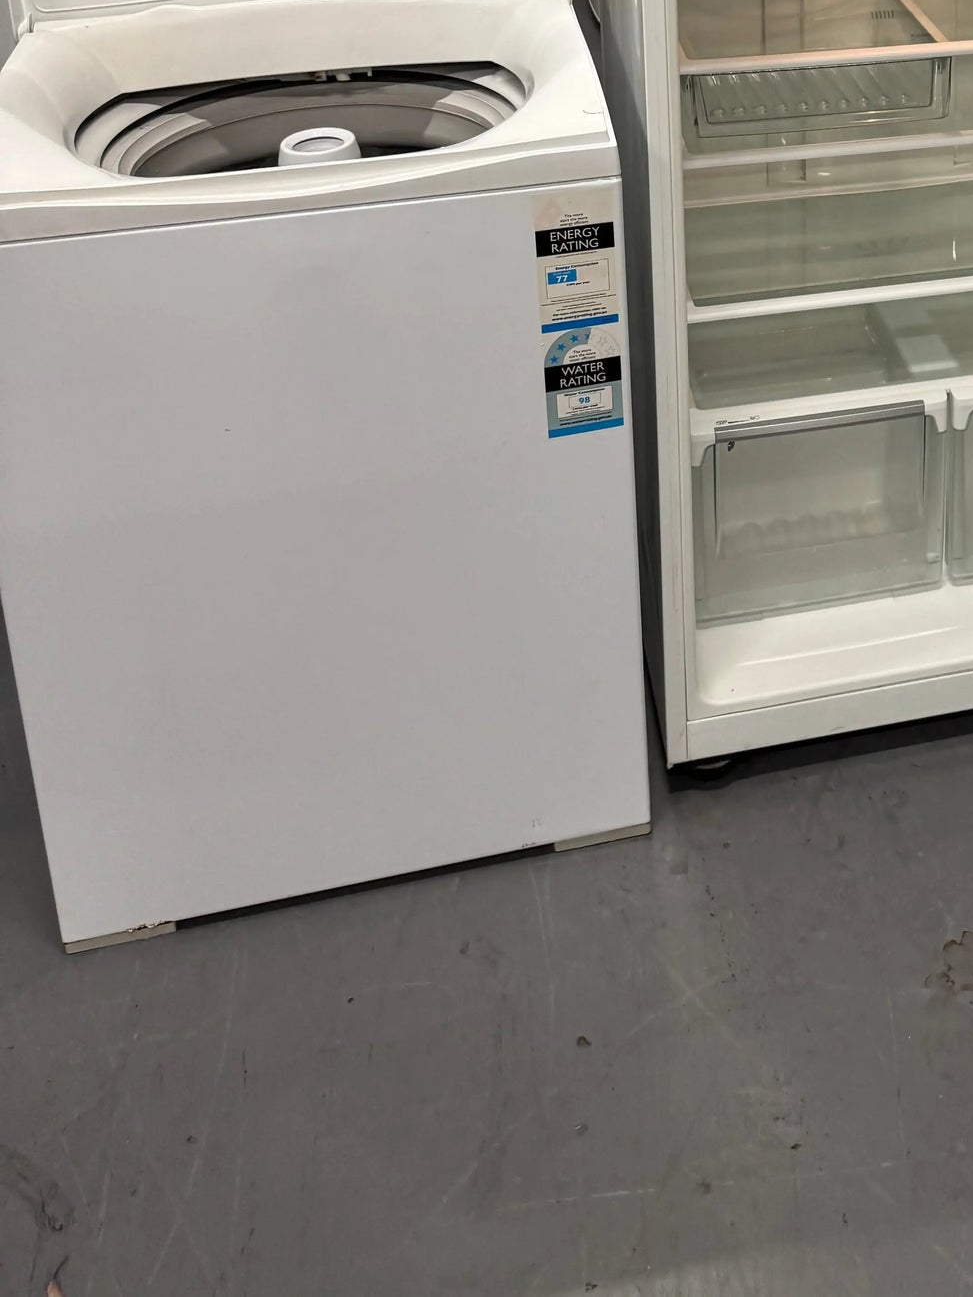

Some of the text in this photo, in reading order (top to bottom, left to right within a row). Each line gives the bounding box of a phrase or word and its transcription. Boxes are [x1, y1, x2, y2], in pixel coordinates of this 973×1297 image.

[549, 226, 600, 242] ENERGY
[551, 238, 599, 253] RATING
[556, 274, 568, 283] 77
[561, 361, 605, 376] WATER
[560, 372, 606, 388] RATING
[578, 396, 591, 404] 98
